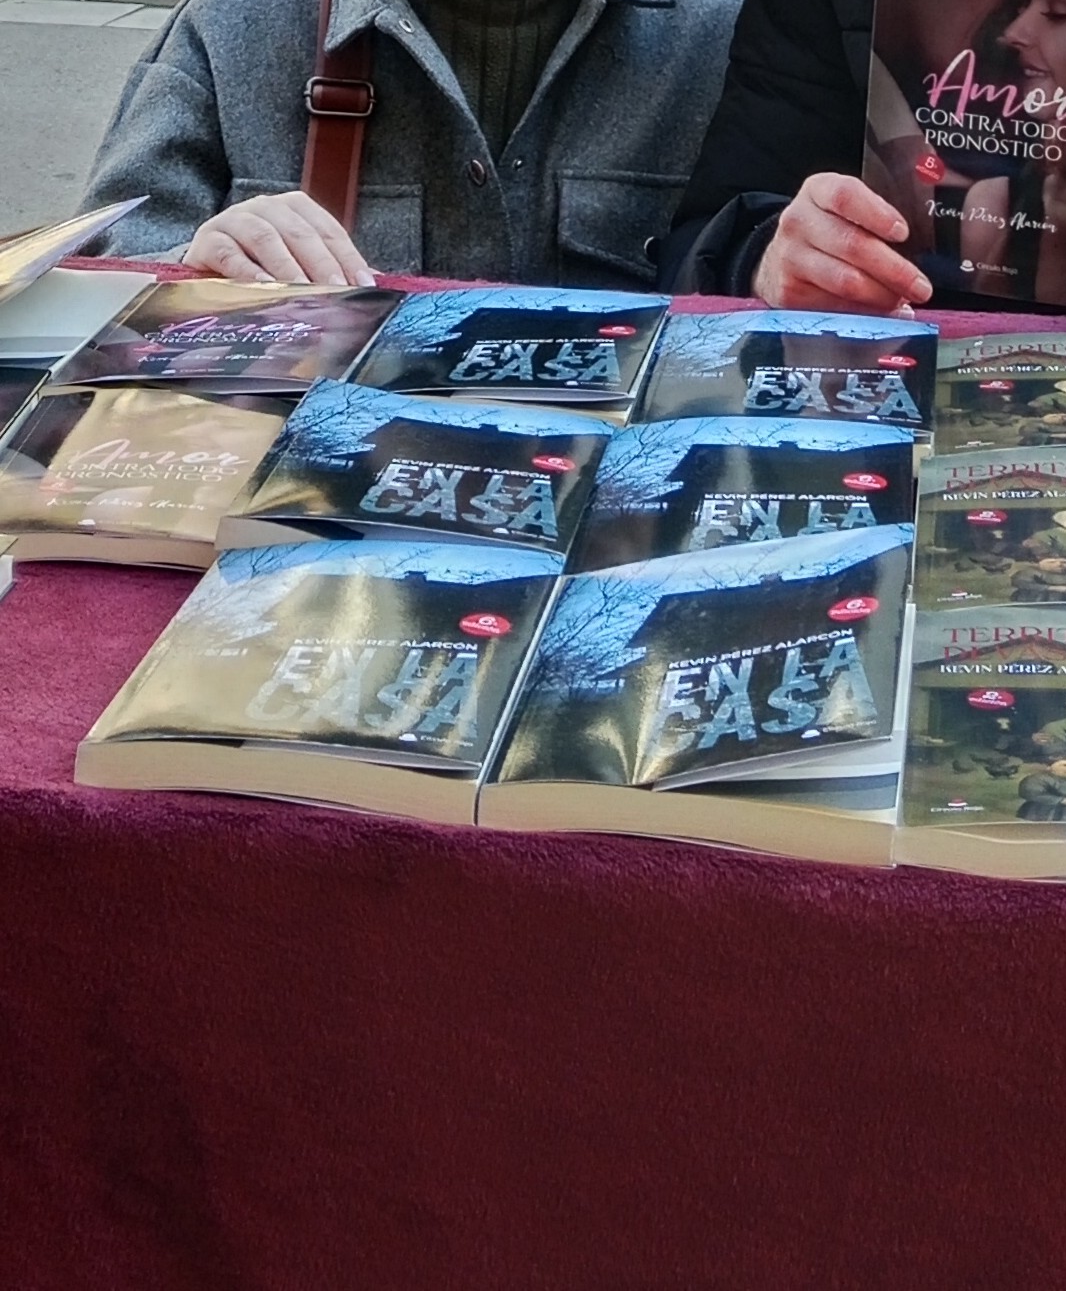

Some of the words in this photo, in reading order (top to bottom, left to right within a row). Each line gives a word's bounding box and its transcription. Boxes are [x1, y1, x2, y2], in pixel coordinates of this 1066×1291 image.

[915, 106, 1006, 135] CONTRA
[925, 128, 1062, 162] PRONÓSTICO
[449, 358, 621, 382] CASA
[943, 492, 988, 501] KEVIN
[359, 483, 559, 538] CASA
[660, 657, 753, 707] EN
[782, 636, 857, 686] LA
[668, 655, 717, 669] KEVIN
[940, 663, 992, 674] KEVIN
